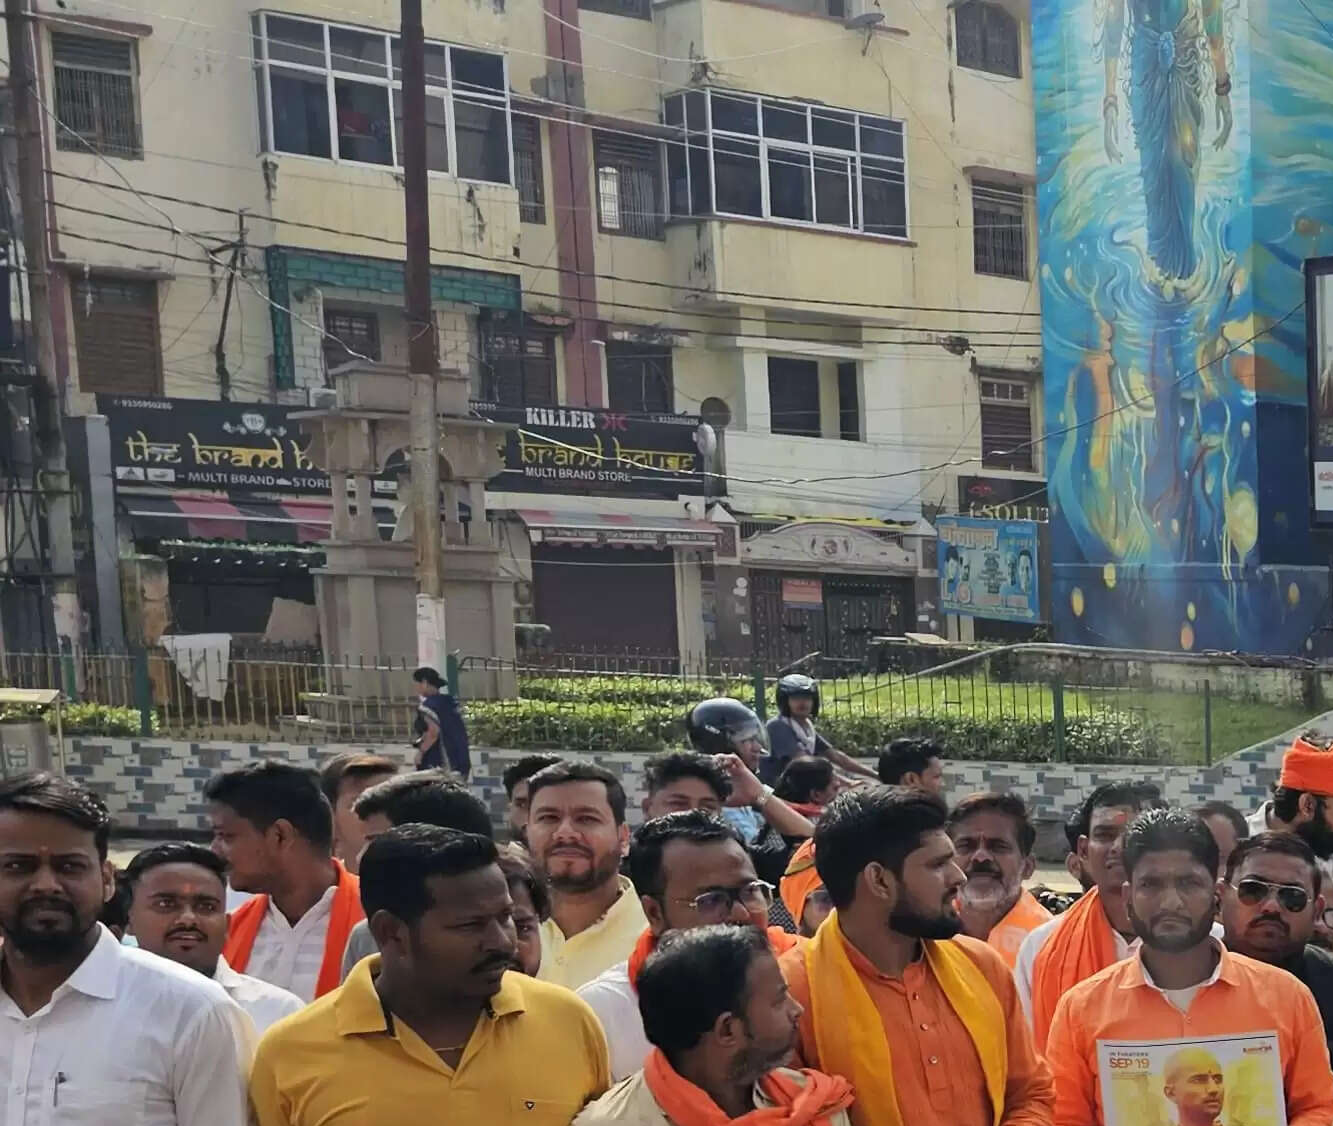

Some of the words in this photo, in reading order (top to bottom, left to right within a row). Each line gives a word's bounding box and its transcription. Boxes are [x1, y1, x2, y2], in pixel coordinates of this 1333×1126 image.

[525, 407, 596, 430] KILLER
[124, 430, 182, 464] the
[187, 432, 285, 469] brand
[518, 429, 606, 469] brand
[188, 471, 229, 484] MULTI
[230, 474, 275, 486] BRAND
[525, 467, 557, 478] MULTI
[558, 468, 596, 480] BRAND
[597, 471, 632, 483] STORE
[1109, 1057, 1133, 1069] SEP
[1135, 1057, 1150, 1069] 19
